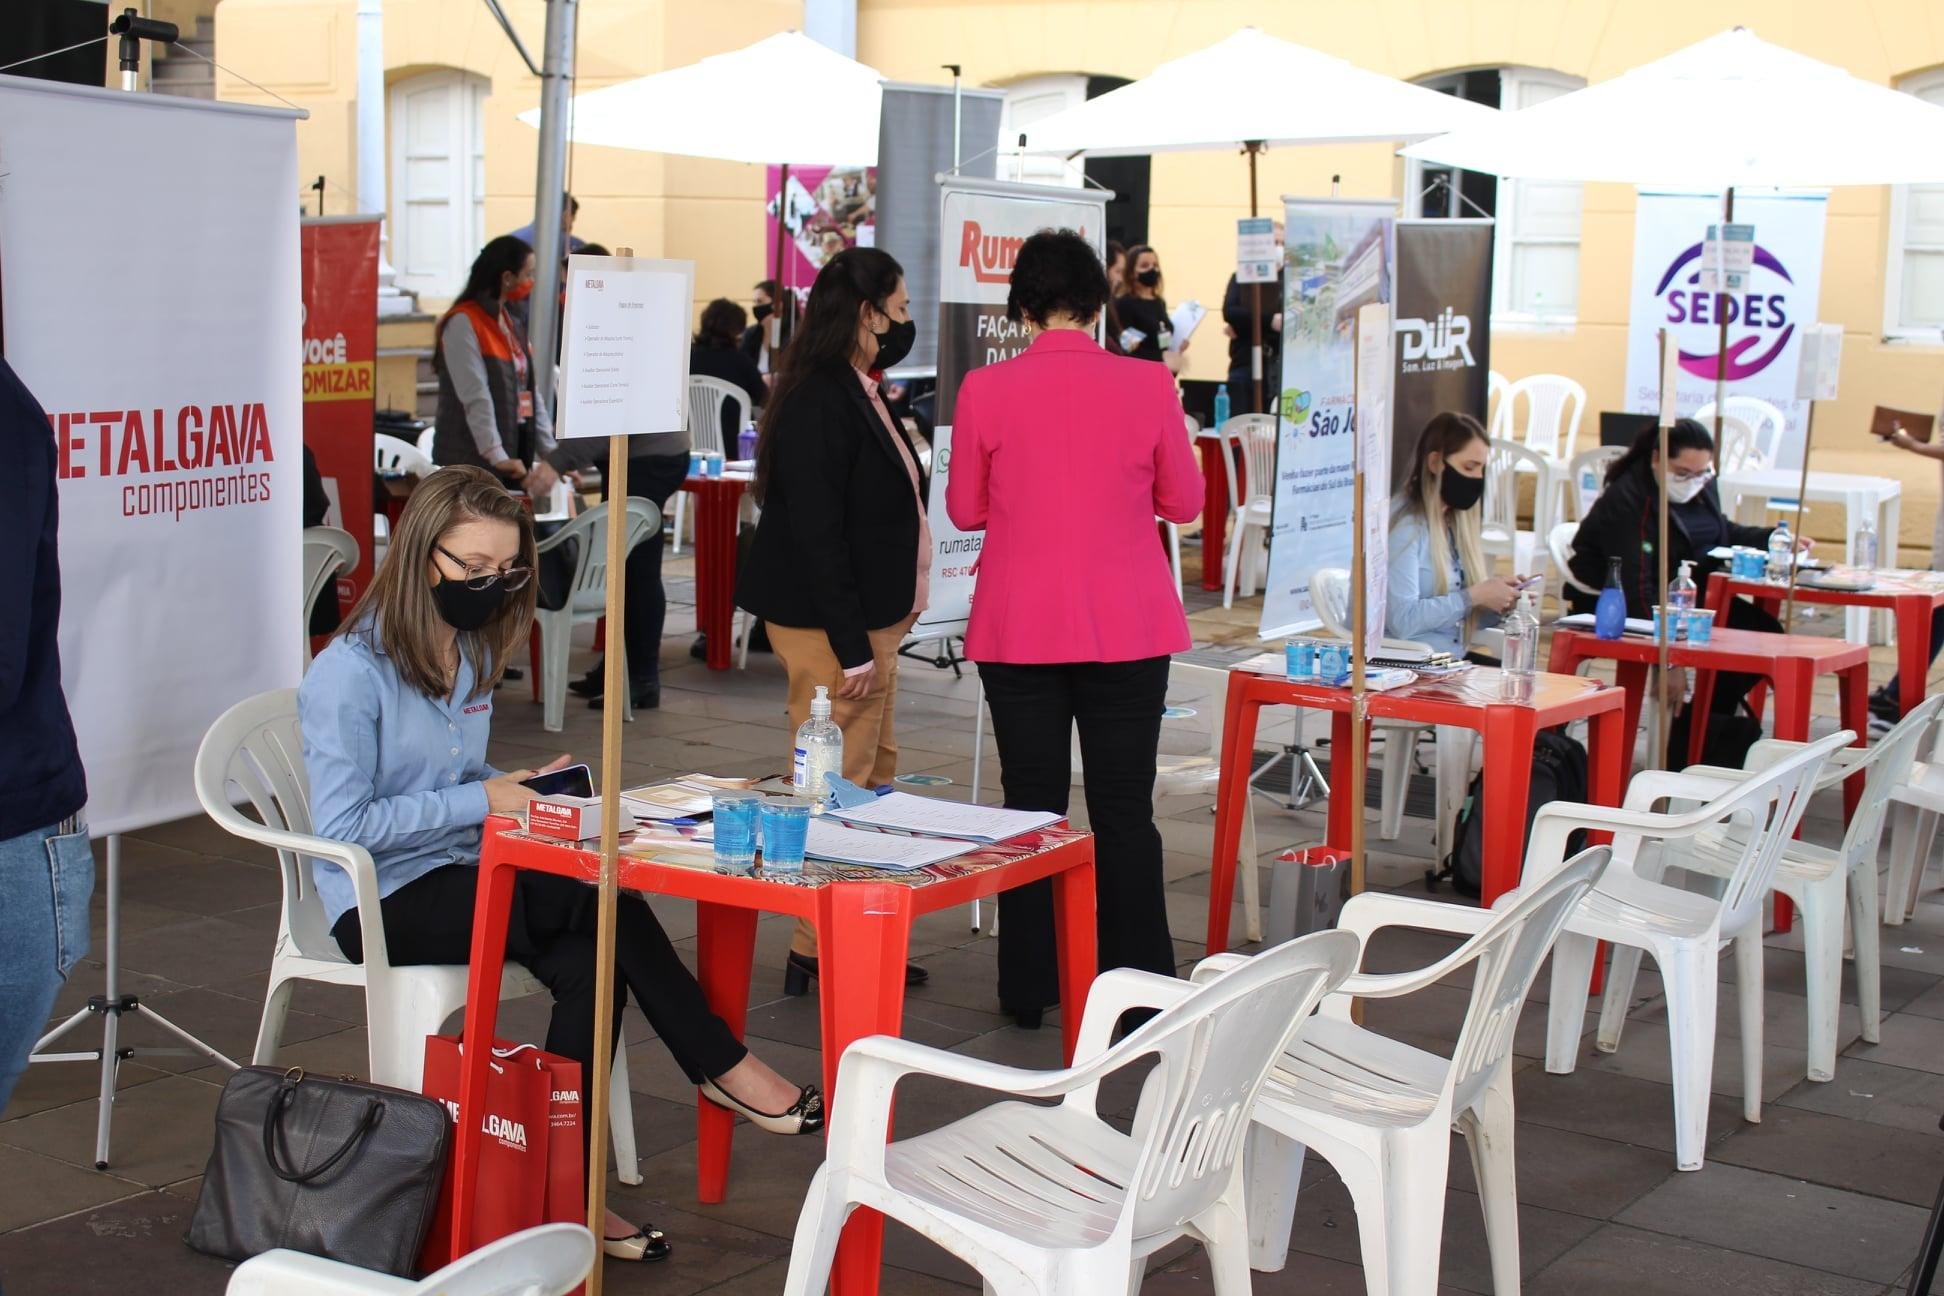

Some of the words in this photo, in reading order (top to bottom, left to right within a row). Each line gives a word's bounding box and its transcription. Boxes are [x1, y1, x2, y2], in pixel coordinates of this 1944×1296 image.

[1666, 290, 1786, 329] SEDES
[977, 314, 1019, 343] FAÇA
[303, 367, 371, 395] OMIZAR
[1309, 408, 1339, 438] São
[122, 466, 272, 523] componentes
[939, 535, 982, 555] rumata
[536, 803, 572, 816] METALGAVA
[550, 1090, 580, 1102] GAVA
